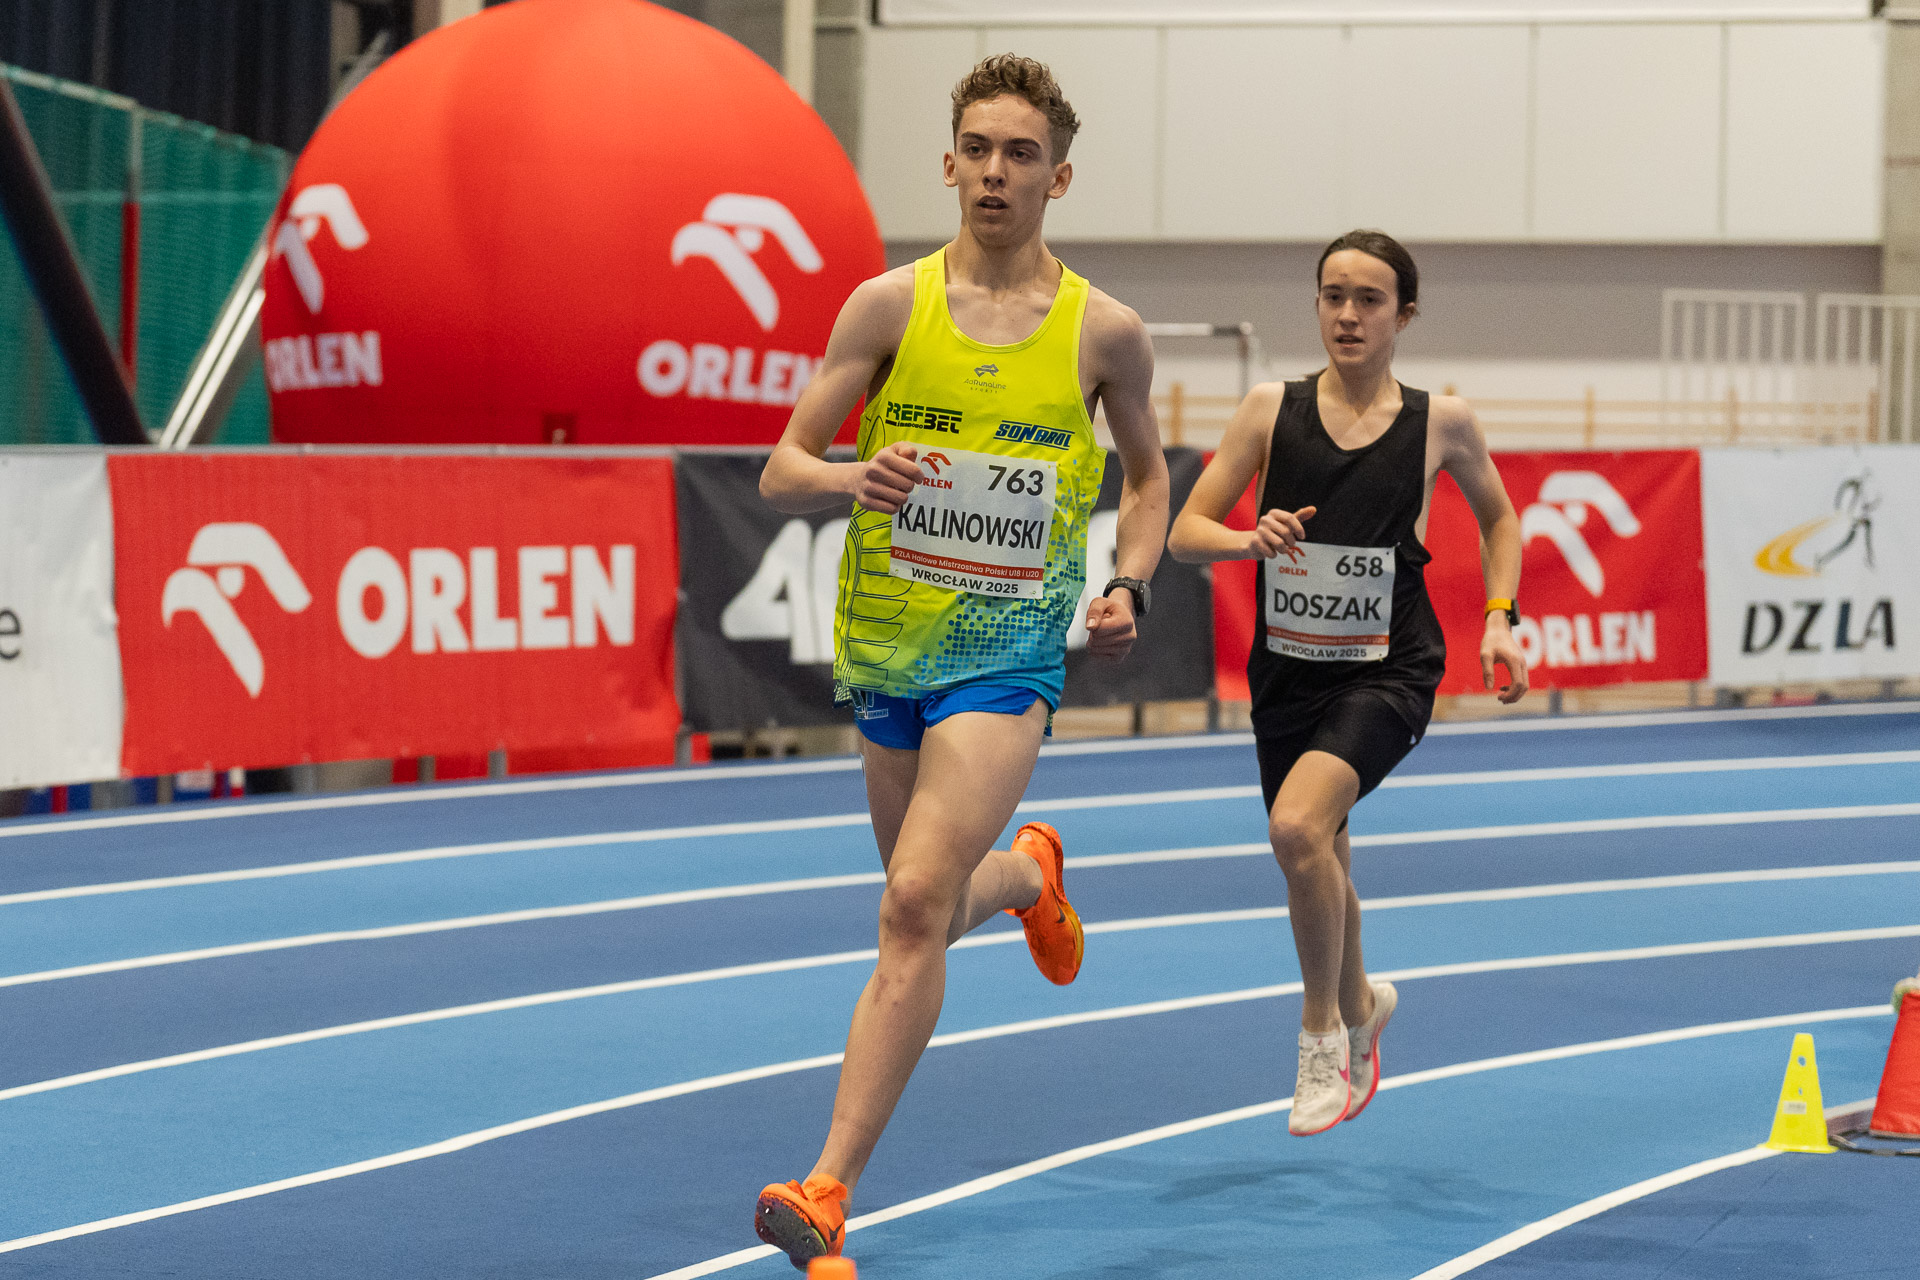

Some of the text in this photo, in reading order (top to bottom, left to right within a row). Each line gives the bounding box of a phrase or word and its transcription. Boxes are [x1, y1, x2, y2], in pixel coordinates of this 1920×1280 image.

[922, 477, 953, 490] RLEN
[988, 465, 1044, 496] 763
[898, 503, 1045, 550] KALINOWSKI
[894, 549, 911, 560] PZLA
[912, 554, 937, 565] Halowe
[938, 560, 984, 573] Mistrzostwa
[985, 566, 1008, 576] Polski
[1026, 571, 1040, 579] U20
[1278, 566, 1308, 577] ORLEN
[1335, 554, 1384, 578] 658
[911, 567, 1019, 595] WROCŁAW 2025
[336, 544, 635, 659] ORLEN
[1274, 588, 1382, 621] DOSZAK
[1511, 610, 1657, 670] ORLEN
[1742, 598, 1895, 655] DZLA
[1282, 642, 1367, 658] WROCŁAW 2025
